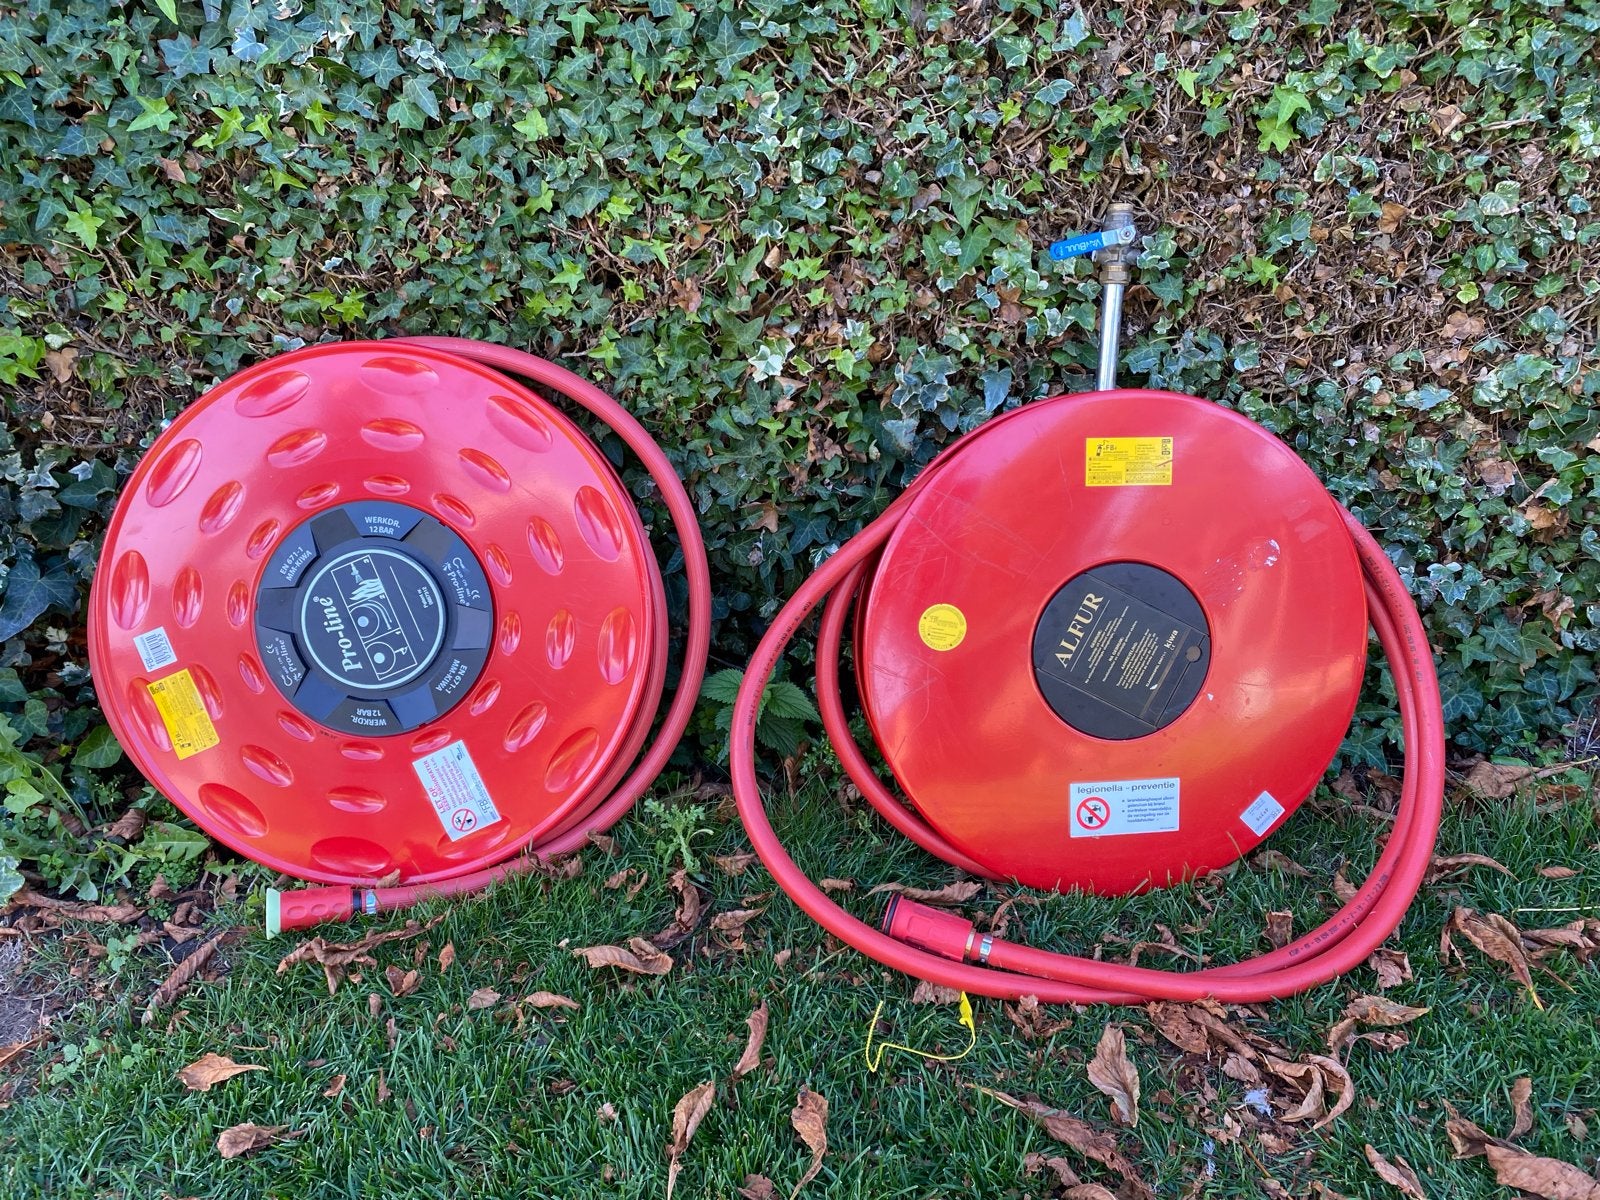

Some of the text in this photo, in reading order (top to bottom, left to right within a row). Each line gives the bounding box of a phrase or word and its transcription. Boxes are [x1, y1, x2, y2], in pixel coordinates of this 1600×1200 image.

[365, 516, 400, 528] WERKDR.
[280, 546, 304, 575] EN 671-1
[286, 550, 312, 582] MM-KIWA
[1055, 593, 1104, 669] ALFUR
[1164, 629, 1179, 648] kiwa
[435, 659, 461, 693] MM-KIWA
[445, 664, 467, 694] EN 671-1
[351, 715, 387, 726] WERKDR.
[428, 786, 446, 814] LET OP
[1077, 784, 1123, 794] legionella
[1131, 782, 1175, 792] preventie
